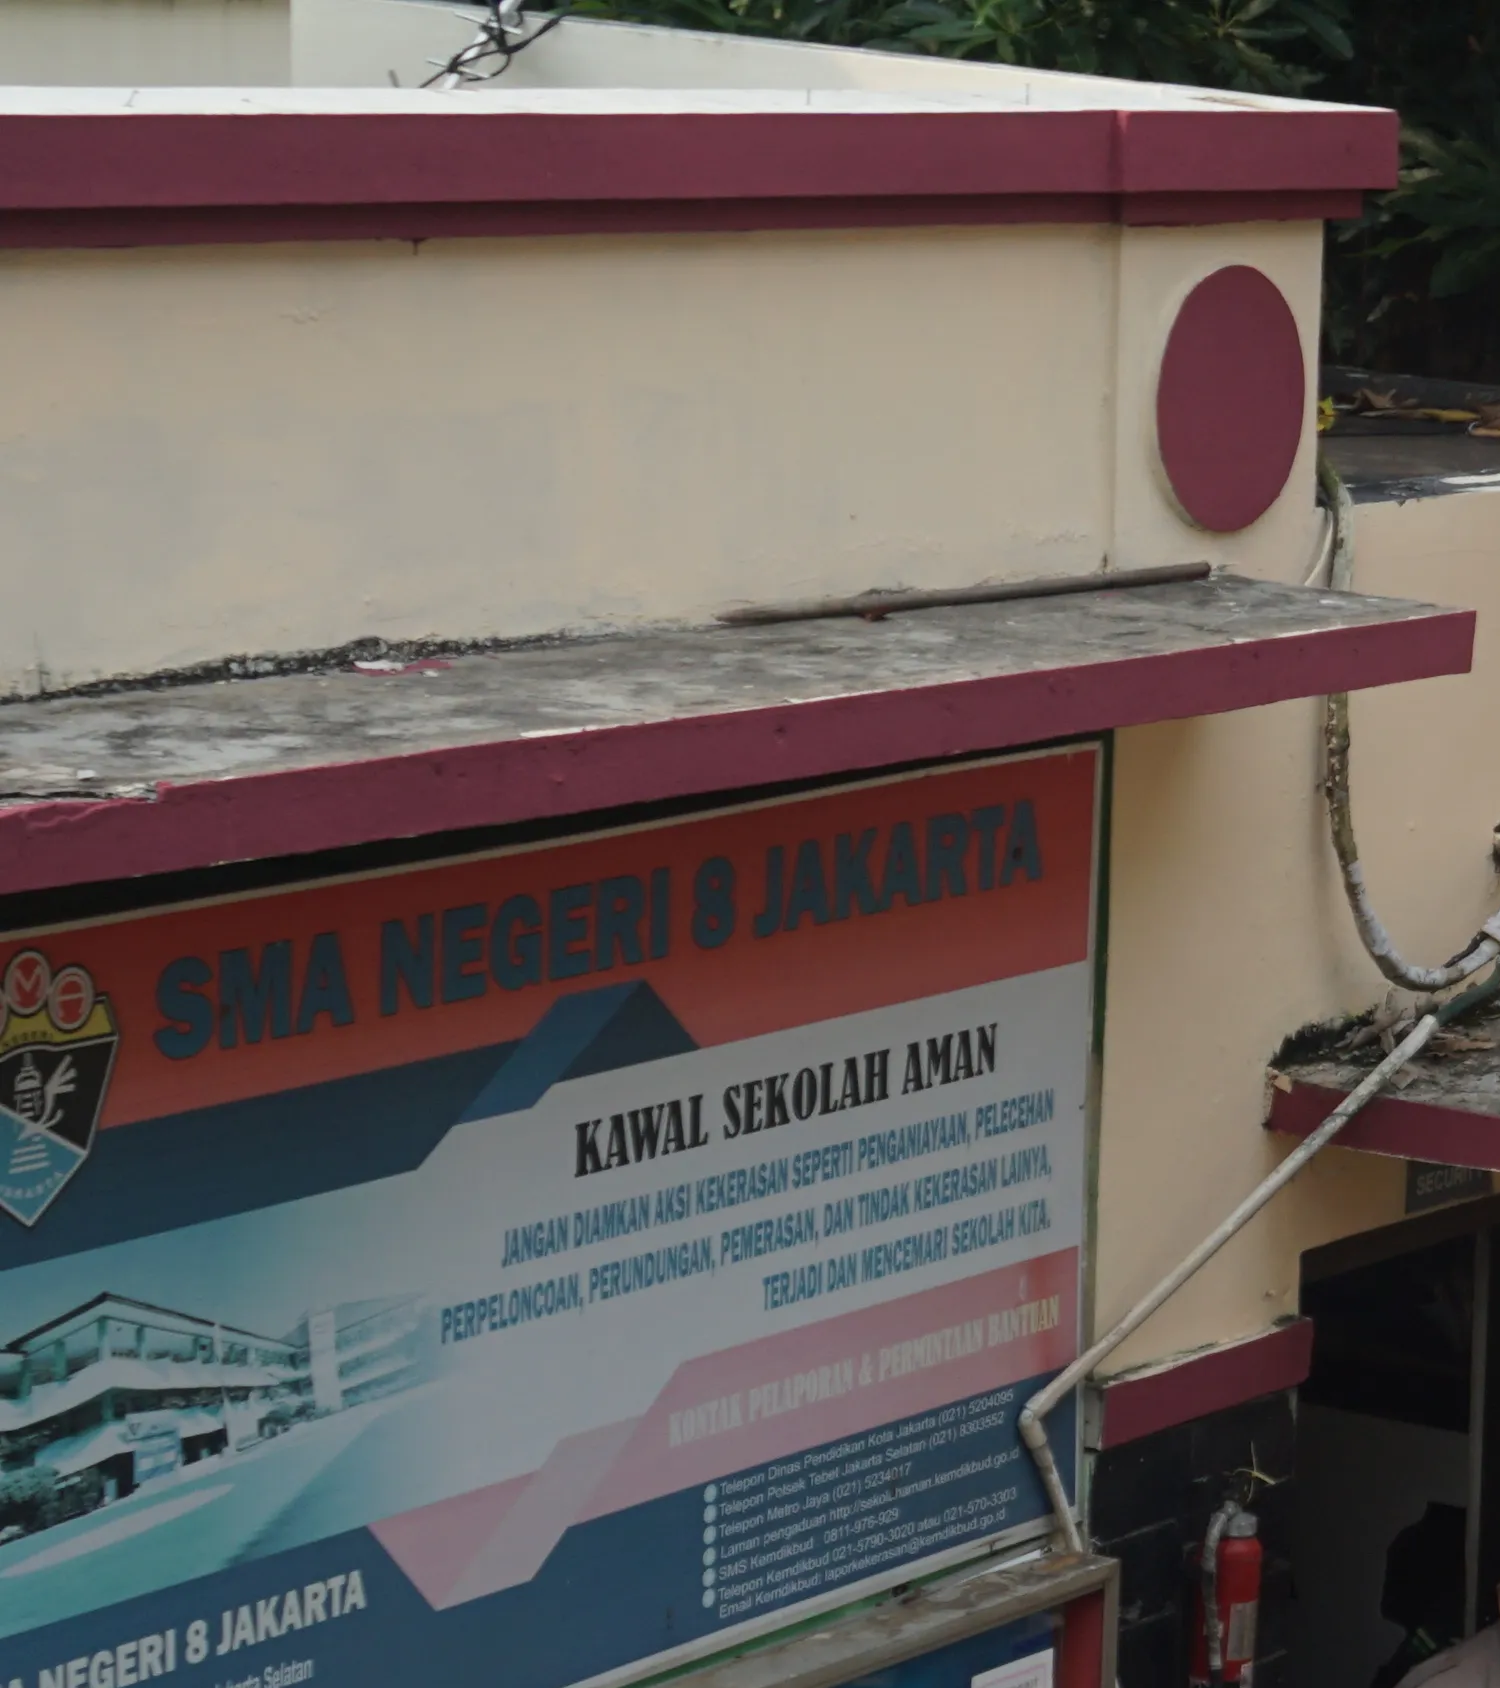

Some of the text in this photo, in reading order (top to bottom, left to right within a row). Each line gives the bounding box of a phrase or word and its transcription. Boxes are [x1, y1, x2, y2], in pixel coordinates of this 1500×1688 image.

[153, 800, 1042, 1061] SMA NEGERI 8 JAKARTA
[575, 1022, 999, 1178] KAWAL SEKOLAH AMAN
[501, 1088, 1056, 1268] JANGAN DIAMKAN AKSI KEKERASAN SEPERTI PENGANIAYAAN, PELECEHAN
[440, 1144, 1052, 1345] PERPELONCOAN, PERUNDUNGAN, PEMERASAN, DAN TINDAK KEKERASAN LAINYA,
[762, 1198, 1052, 1311] TERJADI DAN MENCEMARI SEKOLAH KITA.
[668, 1294, 1061, 1448] KONTAK PELAPORAN & PERMINTAAN BANTUAN
[719, 1494, 764, 1518] Telepon
[767, 1479, 805, 1500] Polsek
[808, 1467, 839, 1486] Tebet
[841, 1453, 882, 1476] Jakarta
[885, 1439, 926, 1461] Selatan
[929, 1429, 957, 1450] (021)
[720, 1473, 765, 1496] Telepon
[767, 1461, 801, 1480] Dinas
[804, 1440, 865, 1469] Pendidikan
[867, 1430, 893, 1448] Kota
[896, 1416, 935, 1438] Jakarta
[938, 1406, 966, 1427] (021)
[719, 1513, 764, 1538] Telepon
[767, 1500, 799, 1520] Metro
[802, 1491, 829, 1510] Jaya
[832, 1480, 861, 1501] (021)
[720, 1536, 760, 1558] Laman
[763, 1512, 826, 1547] pengaduan
[718, 1576, 763, 1601] Telepon
[766, 1553, 829, 1584] Kemdikbud
[917, 1514, 941, 1532] atau
[718, 1560, 747, 1580] SMS
[750, 1538, 815, 1568] Kemdikbud
[185, 1619, 208, 1664] 8
[216, 1569, 367, 1656] JAKARTA
[719, 1597, 752, 1619] Email
